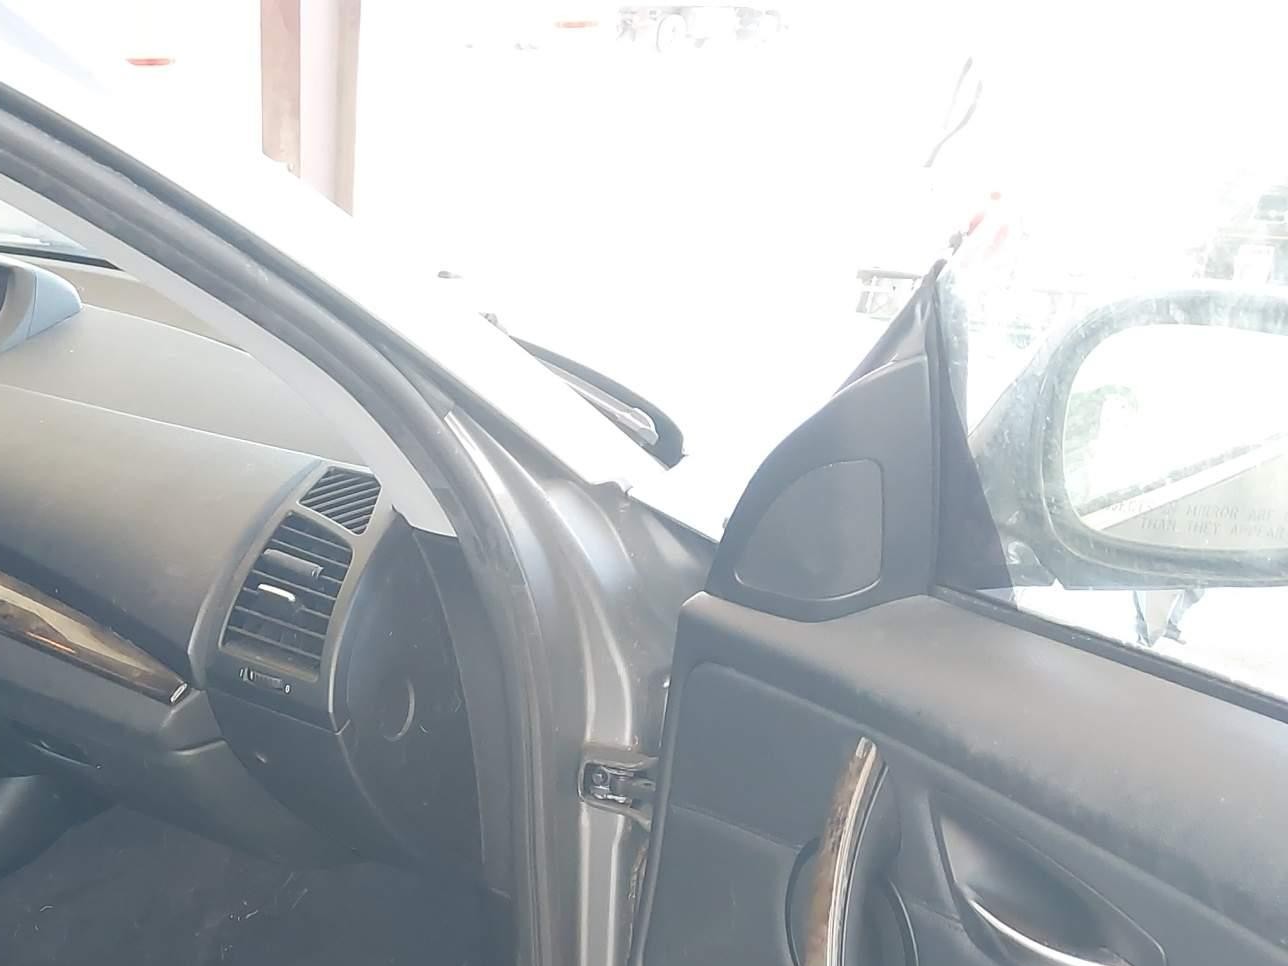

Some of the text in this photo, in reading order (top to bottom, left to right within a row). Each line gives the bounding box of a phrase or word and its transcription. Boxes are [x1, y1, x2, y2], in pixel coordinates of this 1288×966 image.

[1184, 504, 1241, 520] MIRROR
[1137, 518, 1177, 532] THAN
[1184, 521, 1223, 537] THEY
